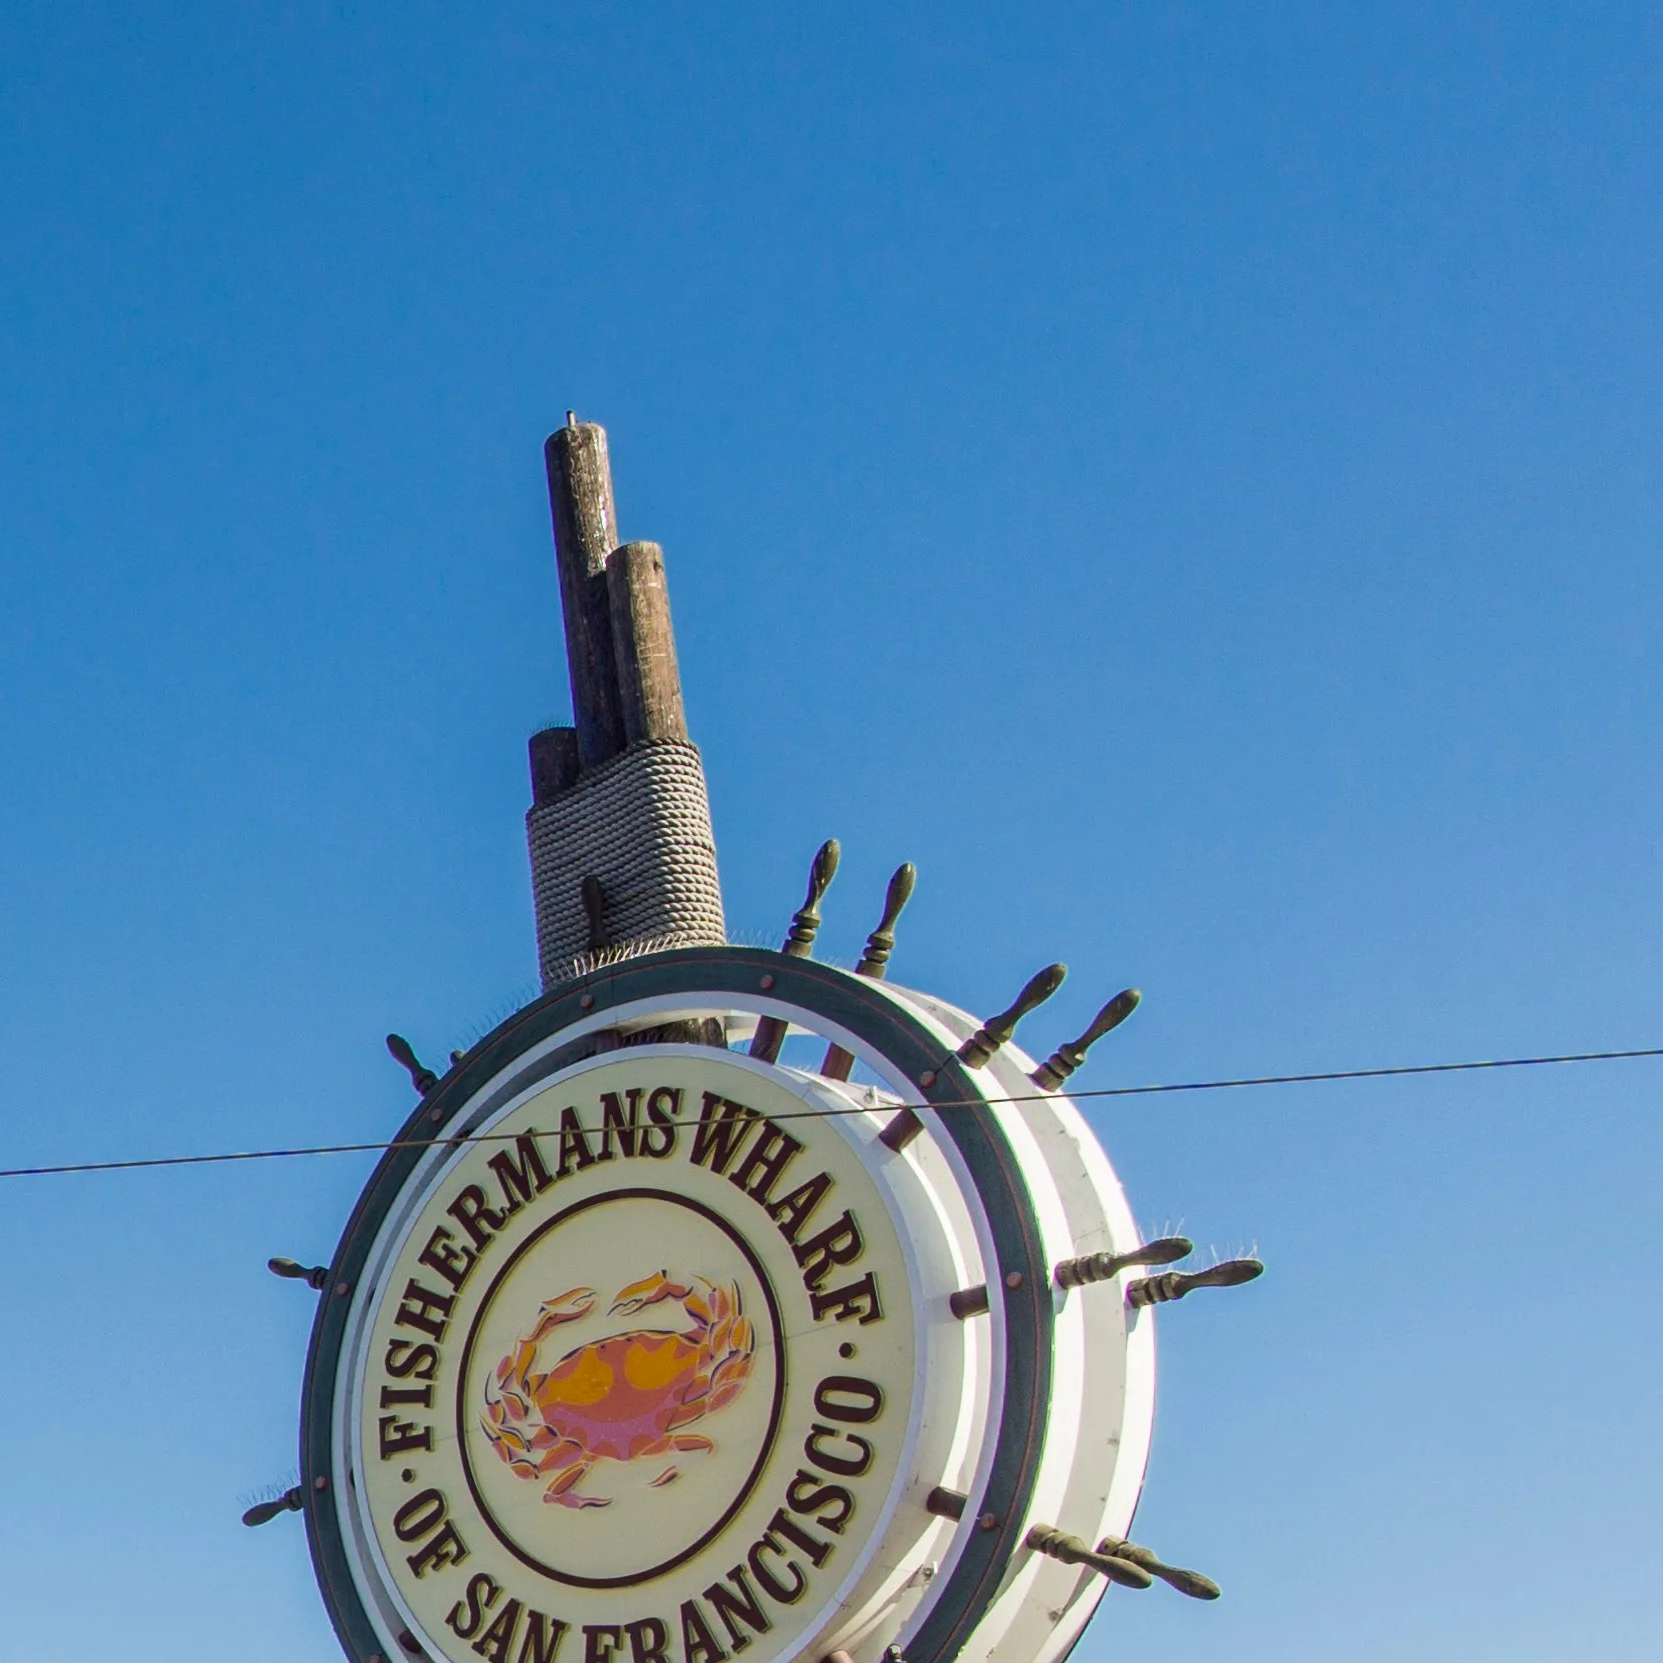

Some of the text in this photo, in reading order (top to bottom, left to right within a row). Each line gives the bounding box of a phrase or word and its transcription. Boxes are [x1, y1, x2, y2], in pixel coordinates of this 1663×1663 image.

[378, 1086, 884, 1461] FISHERMANS WHARF
[392, 1485, 472, 1580] OF
